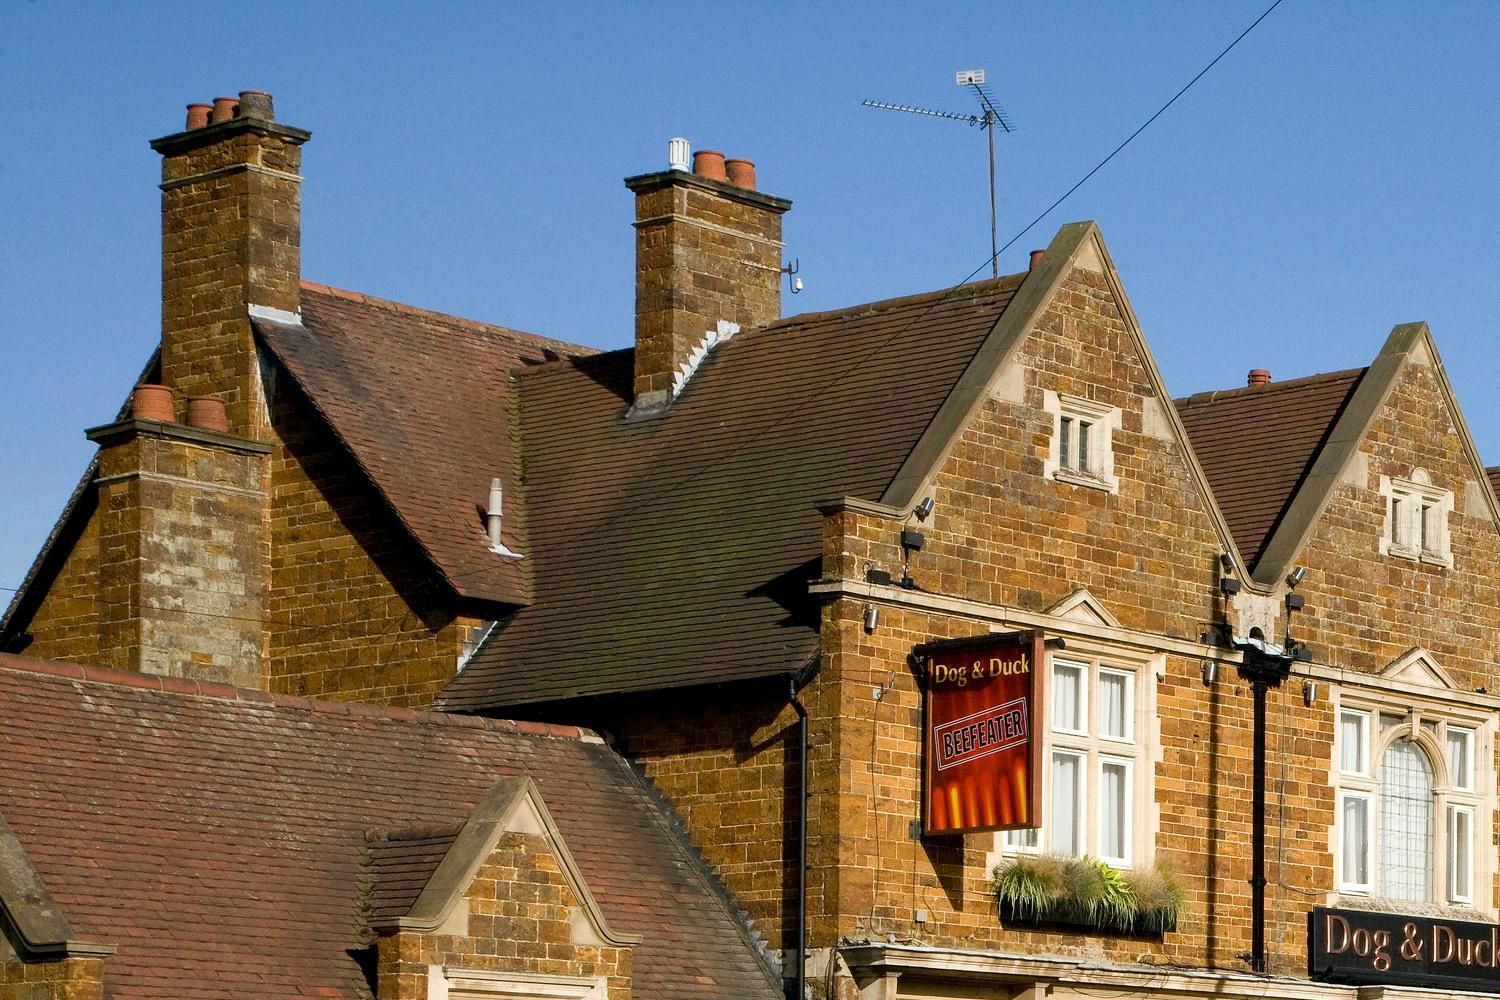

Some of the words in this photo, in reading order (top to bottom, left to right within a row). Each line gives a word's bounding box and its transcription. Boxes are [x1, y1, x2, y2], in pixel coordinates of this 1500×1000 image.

[935, 664, 967, 687] Dog
[971, 660, 984, 680] &
[989, 653, 1030, 678] Duck
[943, 709, 1025, 760] BEEFEATER
[1325, 914, 1392, 972] Dog
[1400, 922, 1424, 961] &
